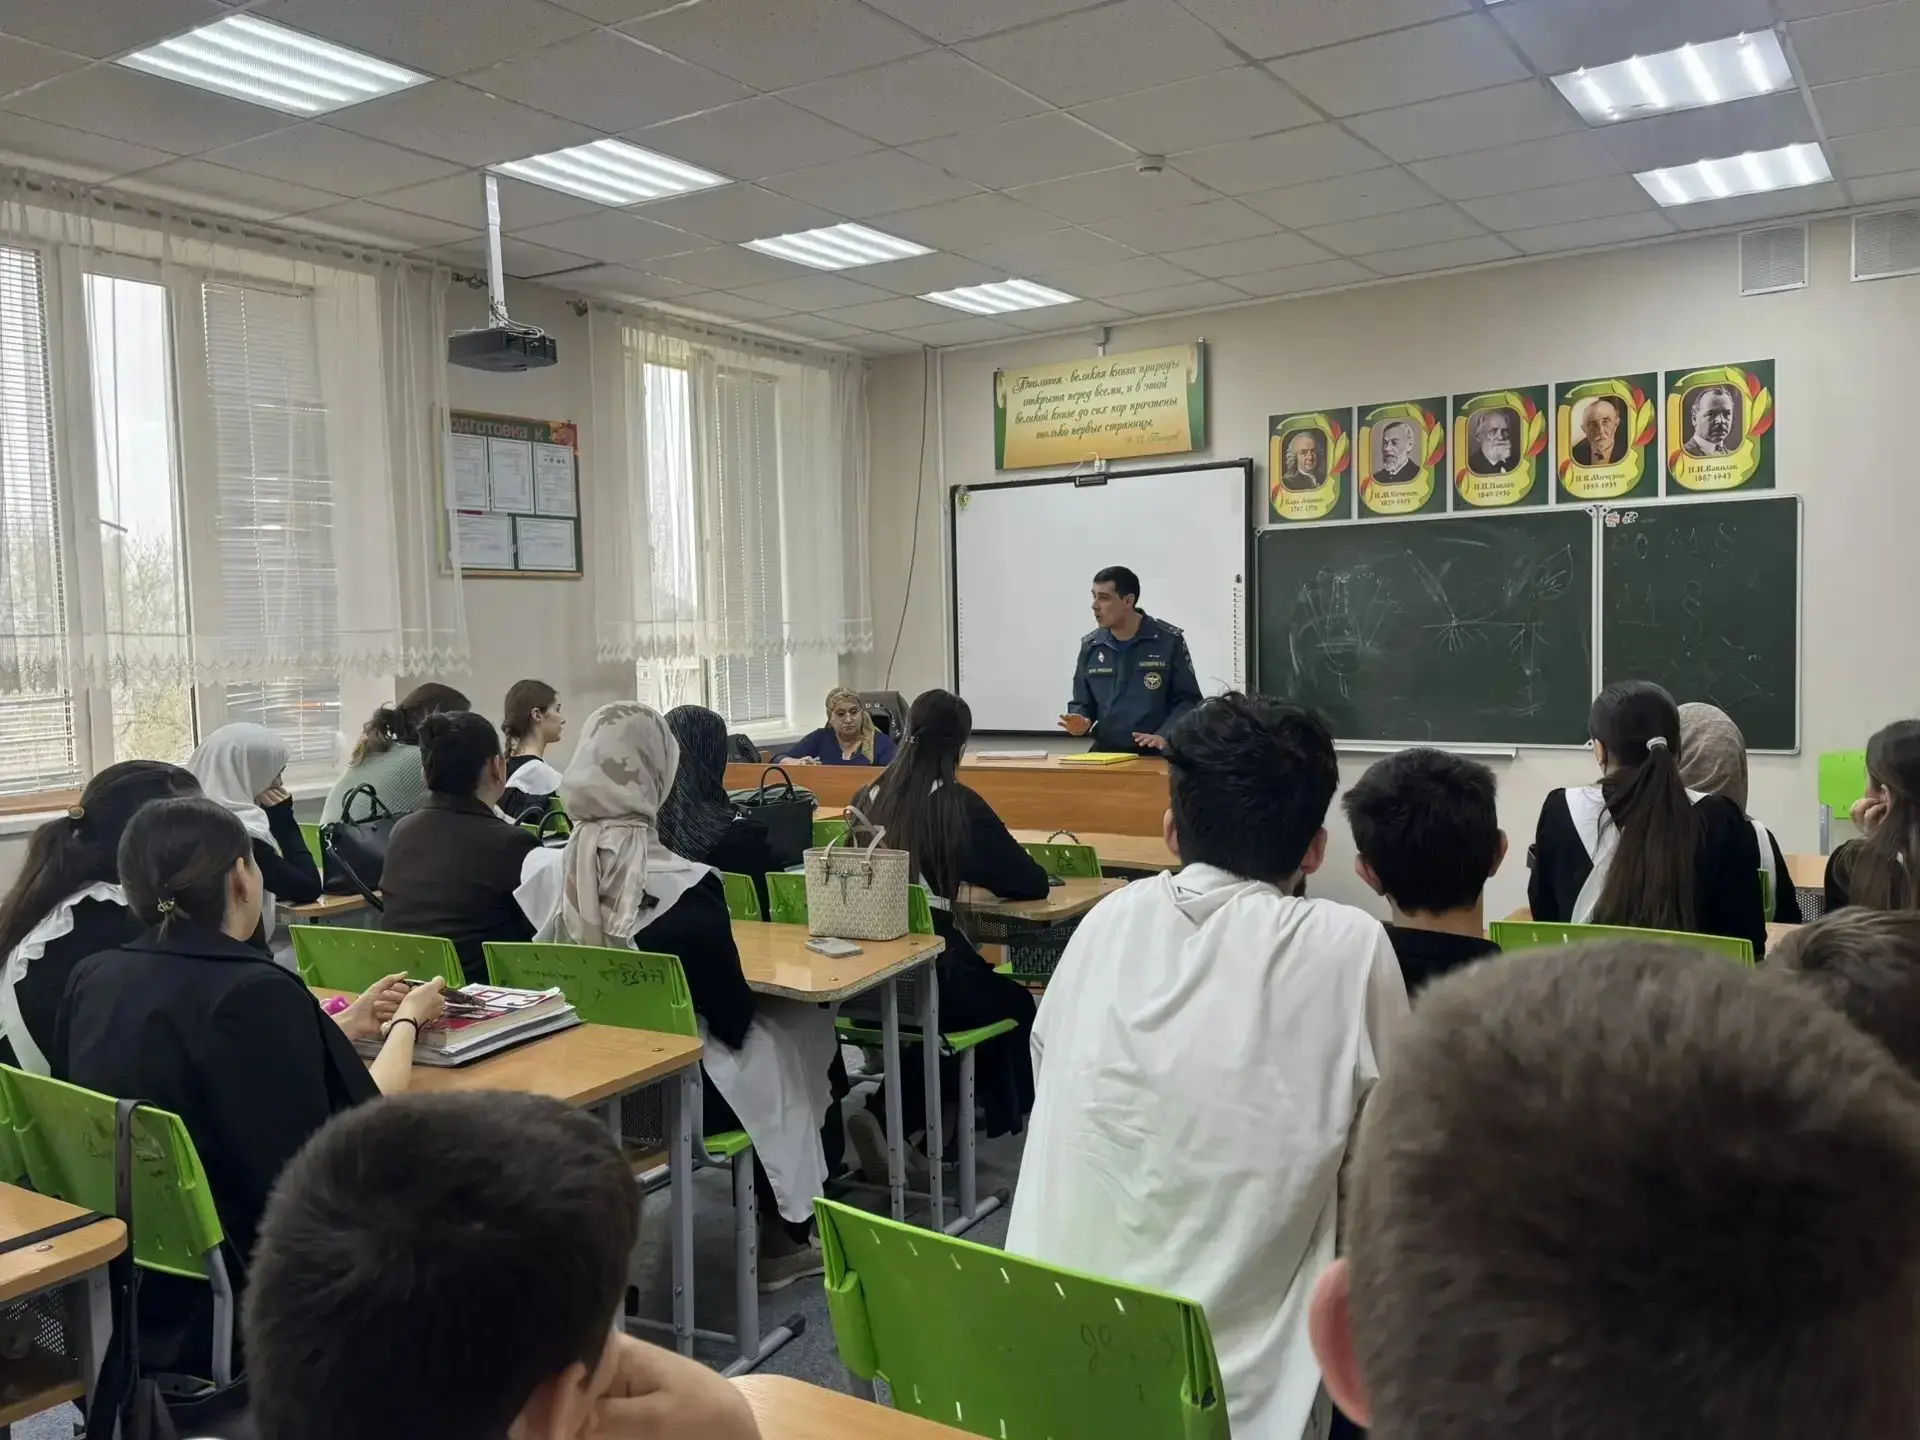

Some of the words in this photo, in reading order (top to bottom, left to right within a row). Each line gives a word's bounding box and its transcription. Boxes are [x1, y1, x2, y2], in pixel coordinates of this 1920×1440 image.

[1012, 376, 1062, 394] Биология
[1070, 365, 1106, 383] великая
[1109, 362, 1136, 377] книга
[1138, 360, 1180, 383] природы
[1023, 391, 1065, 410] открыта
[1067, 390, 1092, 404] перед
[1094, 382, 1124, 397] всеми,
[1126, 385, 1133, 393] и
[1135, 379, 1141, 393] в
[1144, 376, 1168, 391] этой
[1015, 408, 1049, 425] великой
[1051, 406, 1075, 421] книге
[1074, 408, 1089, 422] до
[1091, 405, 1108, 415] сих
[1111, 404, 1127, 417] пор
[1129, 397, 1177, 415] прочтены
[450, 418, 528, 439] одготовка
[1036, 423, 1069, 439] только
[1071, 420, 1102, 440] первые
